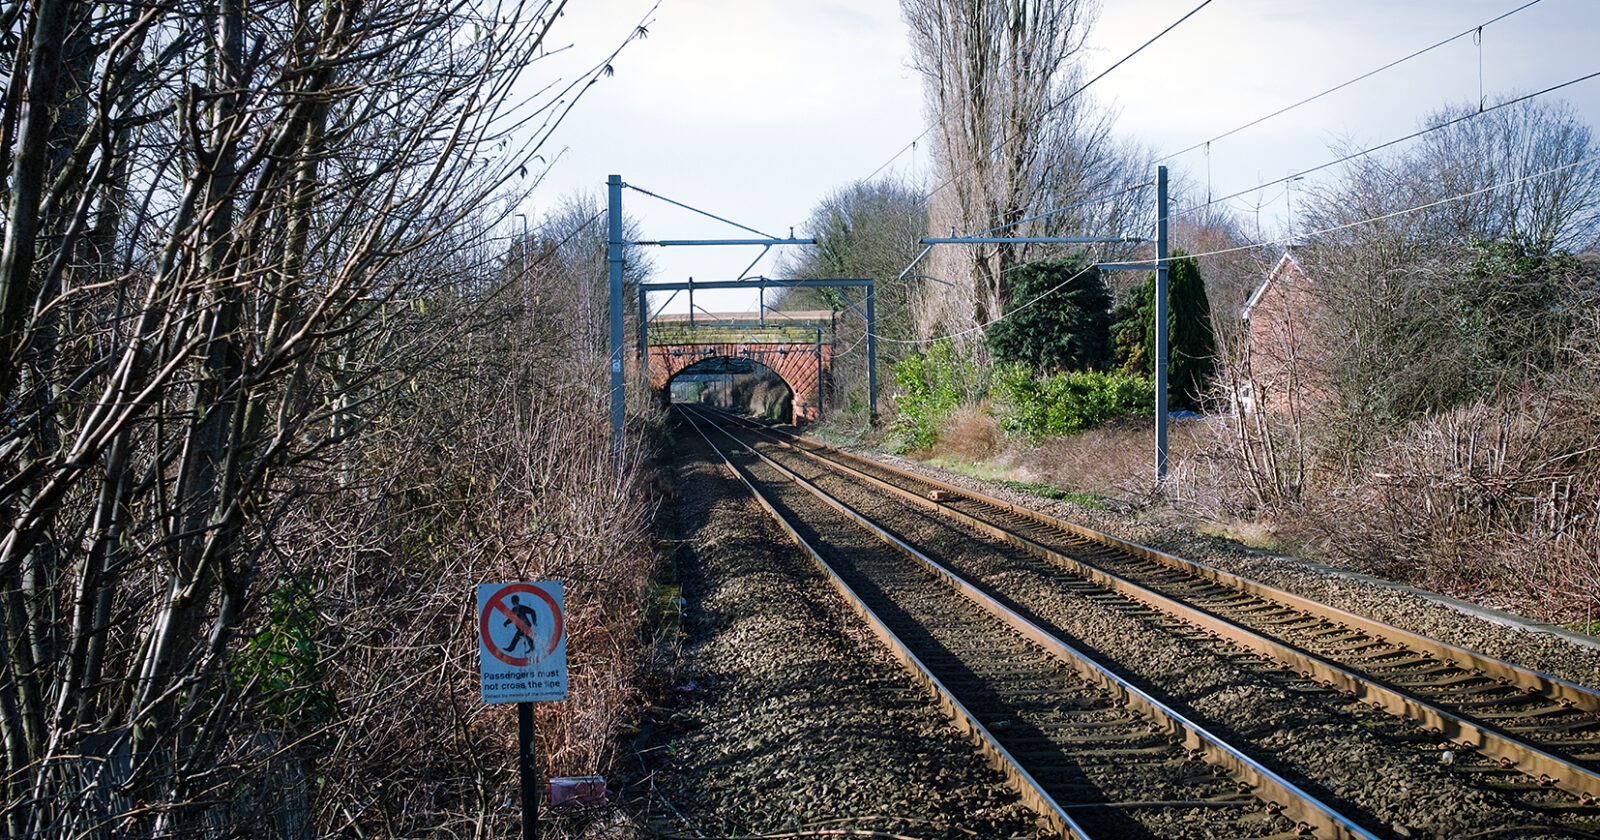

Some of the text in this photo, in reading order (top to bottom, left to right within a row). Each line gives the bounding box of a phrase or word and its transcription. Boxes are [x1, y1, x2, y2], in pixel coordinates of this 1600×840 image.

[484, 669, 559, 681] Passengers must
[484, 680, 561, 690] not cross the ne
